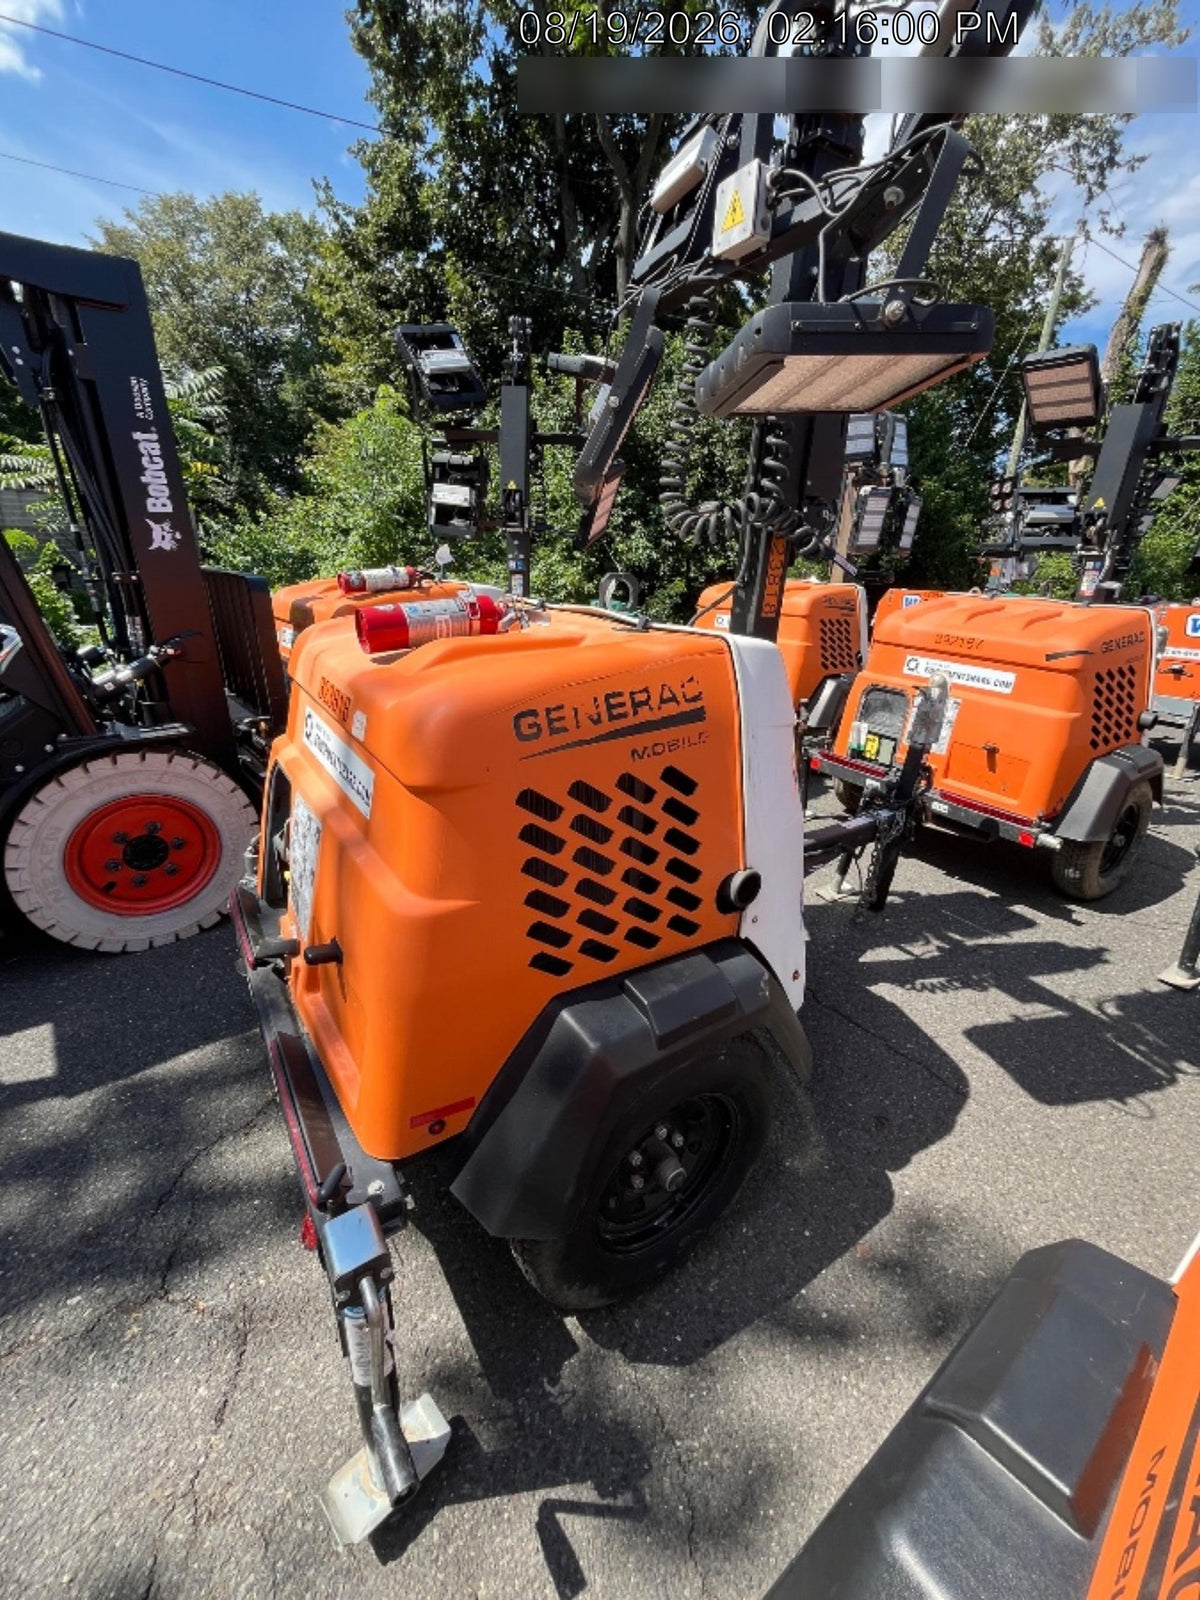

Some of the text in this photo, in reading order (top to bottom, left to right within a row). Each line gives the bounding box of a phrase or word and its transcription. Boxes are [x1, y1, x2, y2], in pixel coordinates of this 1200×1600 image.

[131, 431, 173, 513] Bobcat
[512, 675, 704, 743] GENERAC
[630, 731, 709, 763] MOBILE
